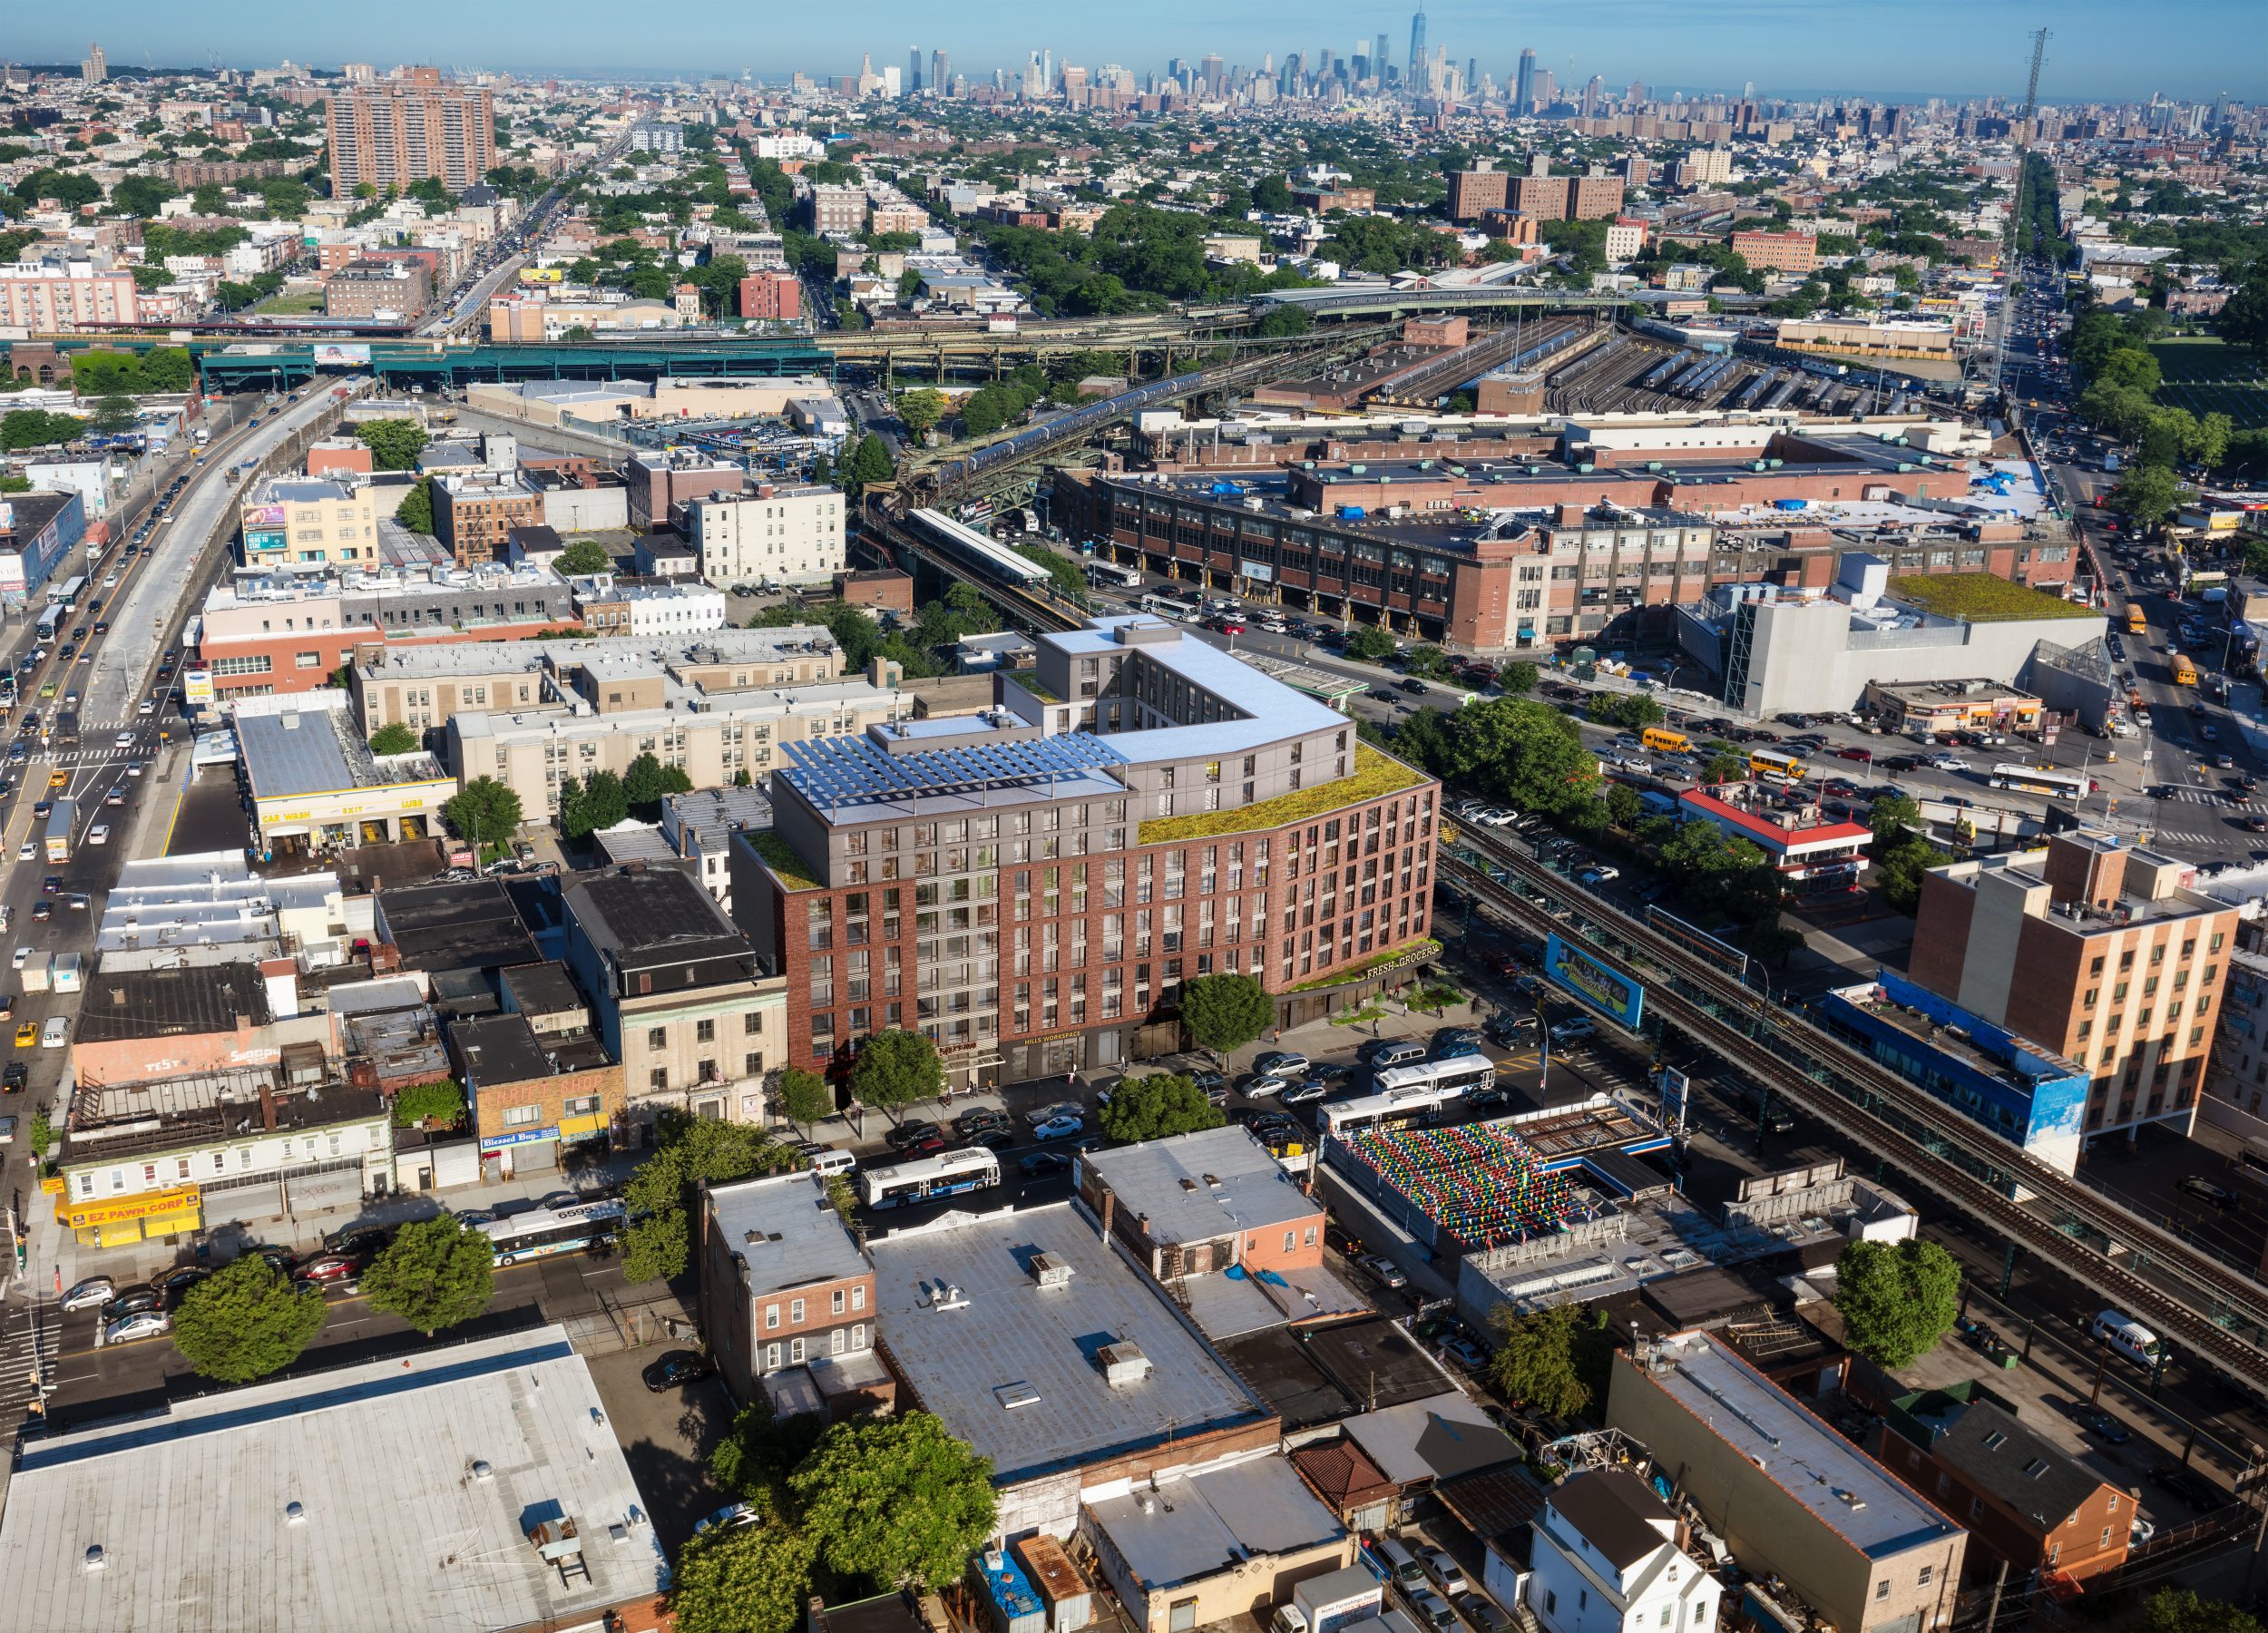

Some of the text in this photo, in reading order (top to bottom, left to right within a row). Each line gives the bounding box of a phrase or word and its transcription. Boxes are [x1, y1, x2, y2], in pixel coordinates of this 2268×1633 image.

[687, 435, 708, 444] Brooklyn
[401, 799, 424, 808] LUBE
[342, 807, 363, 815] EXIT
[262, 812, 311, 824] CAR WASH
[1366, 944, 1439, 980] FRESH GROCERY
[1024, 1031, 1080, 1045] HILLS WORKSPACE
[484, 1074, 602, 1105] THRIFT SHOP
[483, 1135, 516, 1147] Blessed
[89, 1212, 105, 1221] EZ
[109, 1208, 146, 1219] PAWN
[150, 1198, 183, 1212] CORP
[558, 1206, 593, 1219] 6595
